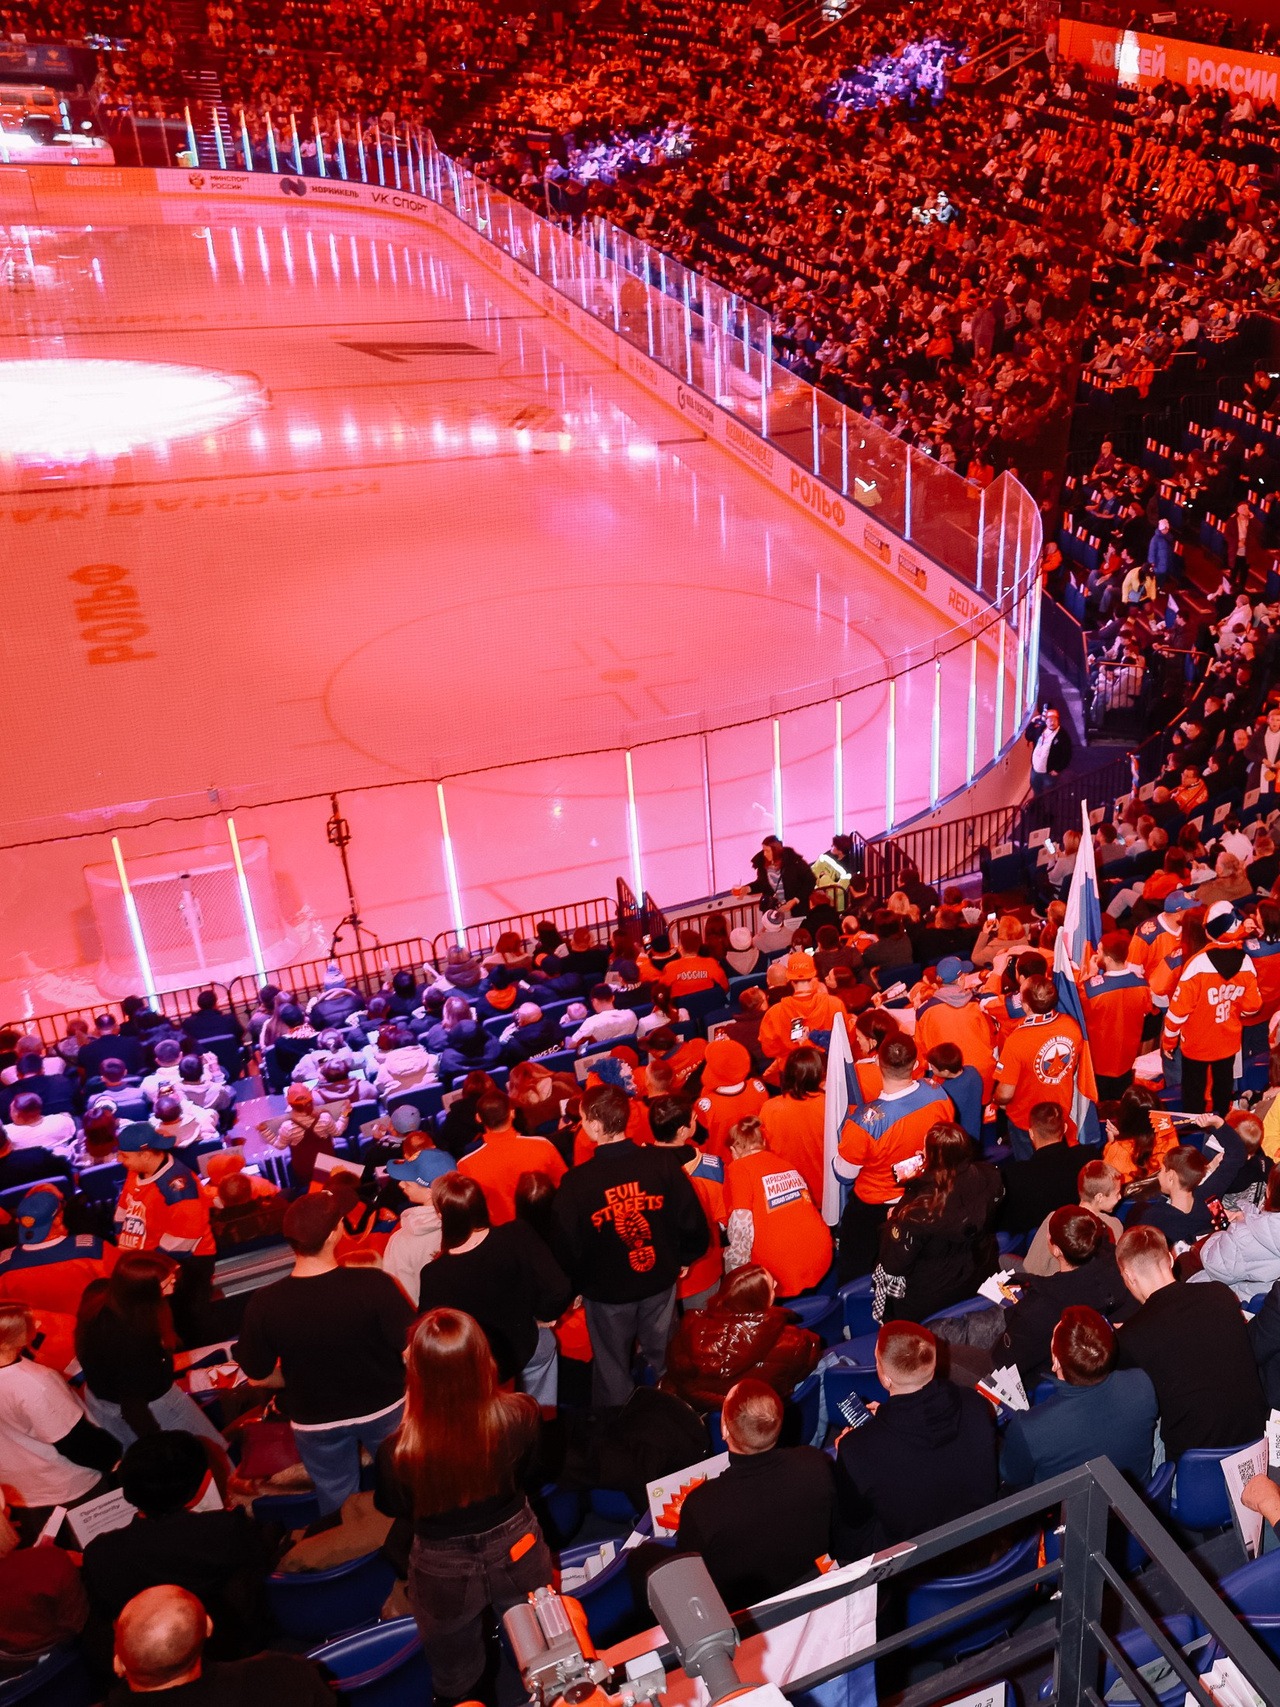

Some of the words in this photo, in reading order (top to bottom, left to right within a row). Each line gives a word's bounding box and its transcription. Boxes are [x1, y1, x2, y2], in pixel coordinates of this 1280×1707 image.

[1187, 56, 1277, 101] РОССИИ
[210, 175, 249, 183] МИНСПОРТ
[311, 185, 359, 198] НОРНИКЕЛЬ
[371, 192, 388, 204] VK
[392, 196, 428, 213] СПОРТ
[790, 468, 846, 528] РОЛЬФ
[949, 587, 970, 618] RED
[68, 563, 158, 666] РОЛЬФ
[1207, 984, 1246, 1005] СССР
[764, 1173, 792, 1186] КРАСНАЯ
[767, 1178, 805, 1197] МАШИНА
[604, 1181, 646, 1205] EVIL
[590, 1195, 664, 1232] STREETS
